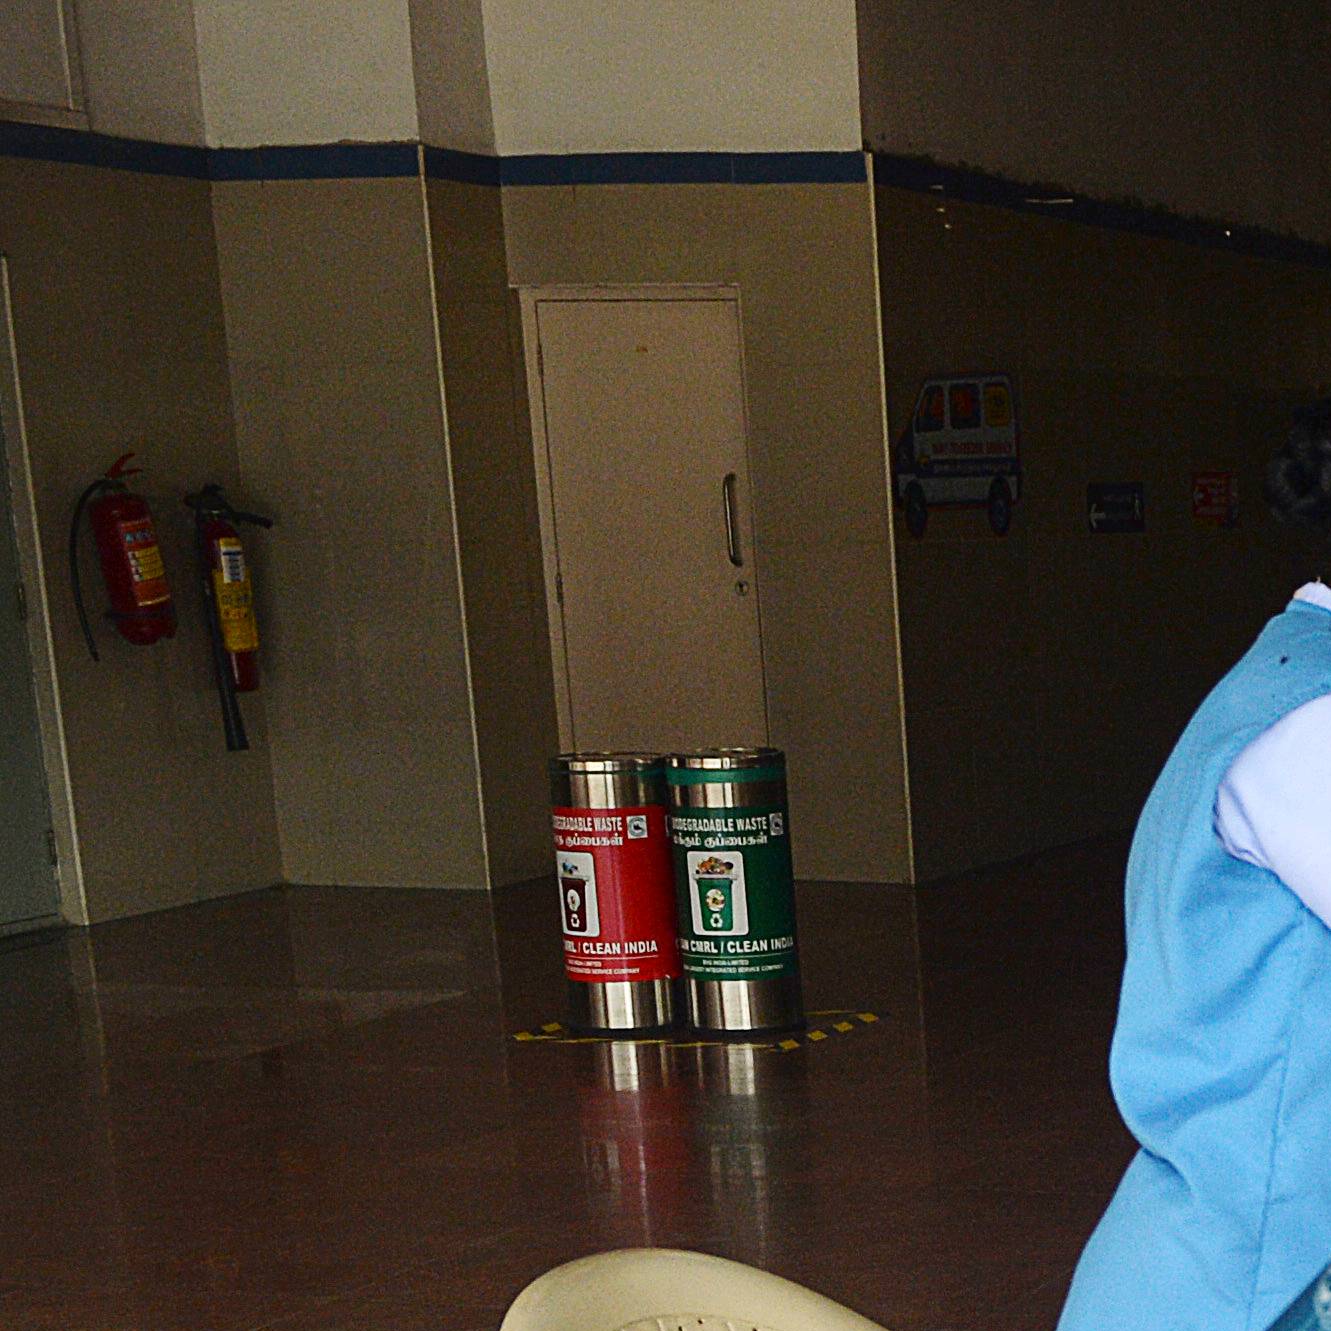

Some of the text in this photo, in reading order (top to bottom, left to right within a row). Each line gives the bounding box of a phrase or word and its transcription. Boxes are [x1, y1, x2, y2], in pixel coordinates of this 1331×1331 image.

[593, 816, 623, 832] WASTE
[735, 816, 768, 831] WASTE
[582, 941, 621, 954] CLEAN
[625, 939, 658, 954] INDIA
[727, 939, 768, 953] CLEAN
